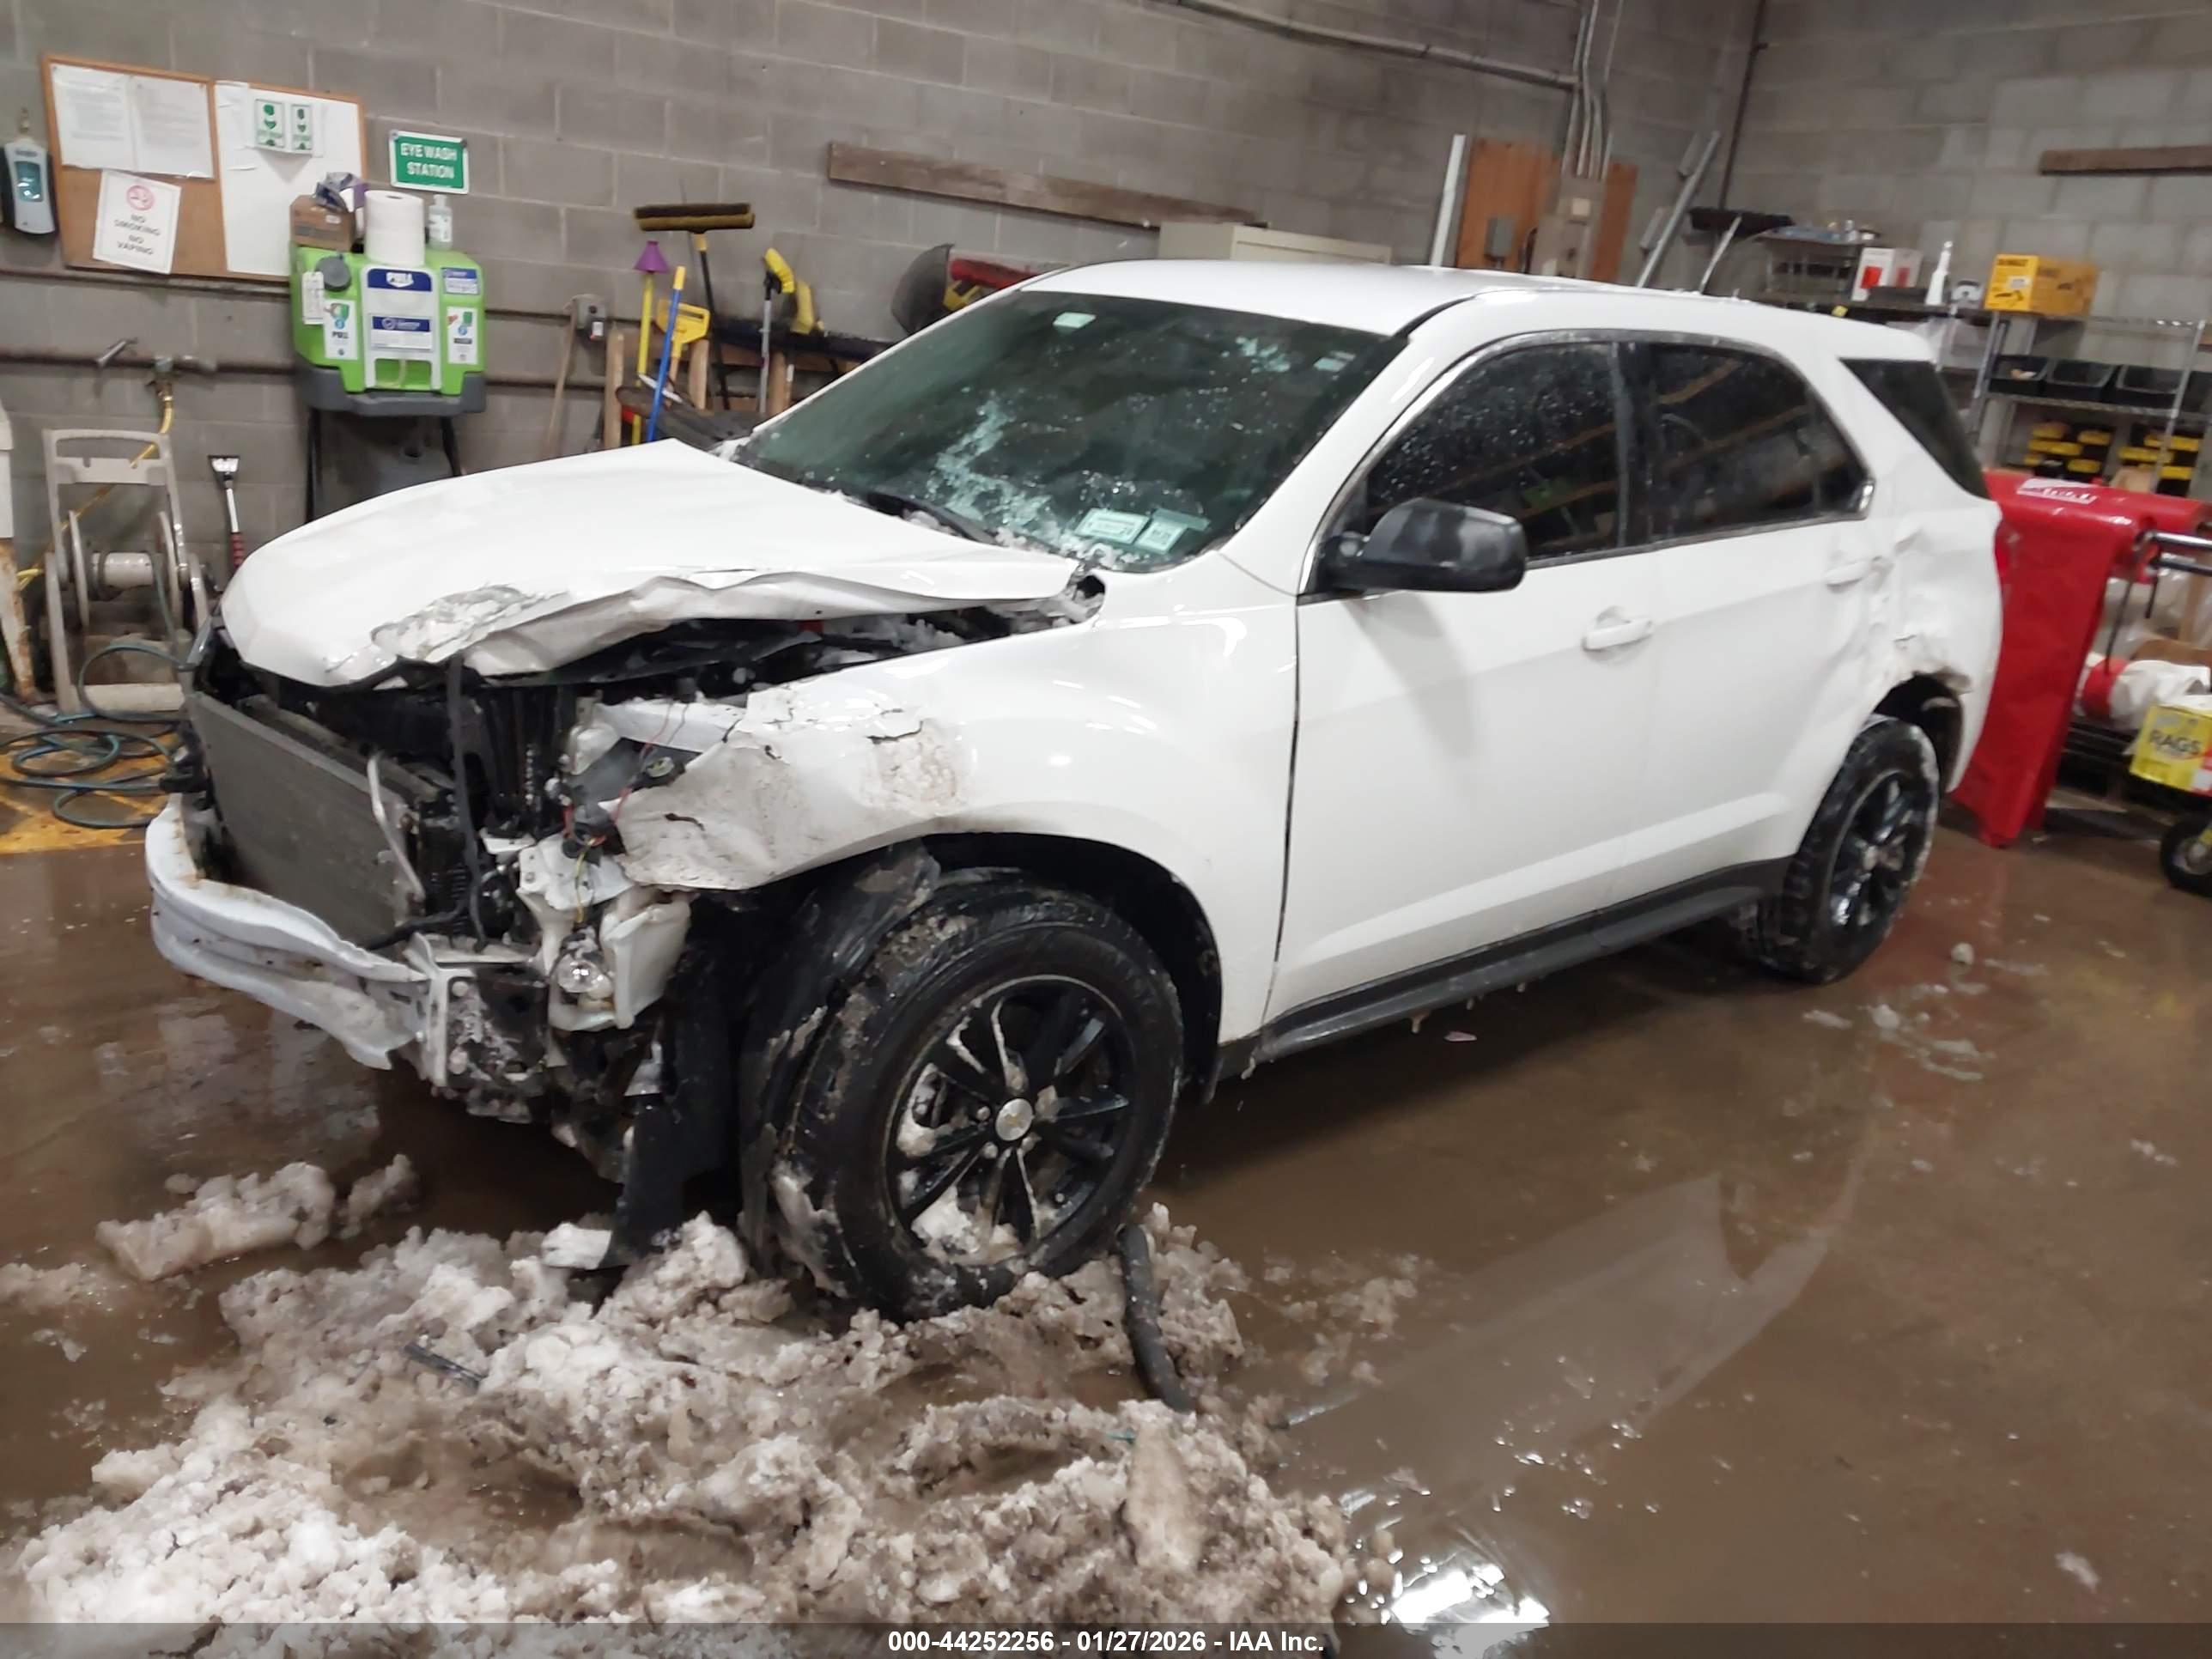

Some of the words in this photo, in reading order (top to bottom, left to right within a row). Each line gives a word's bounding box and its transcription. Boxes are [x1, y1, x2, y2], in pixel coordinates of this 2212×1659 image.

[400, 143, 423, 157] EYE
[424, 145, 457, 161] WASH
[406, 161, 454, 179] STATION
[131, 214, 146, 223] NO
[114, 219, 161, 236] SMOKING
[117, 240, 154, 255] VAPING
[128, 234, 144, 244] NO
[2150, 730, 2201, 755] RAGS
